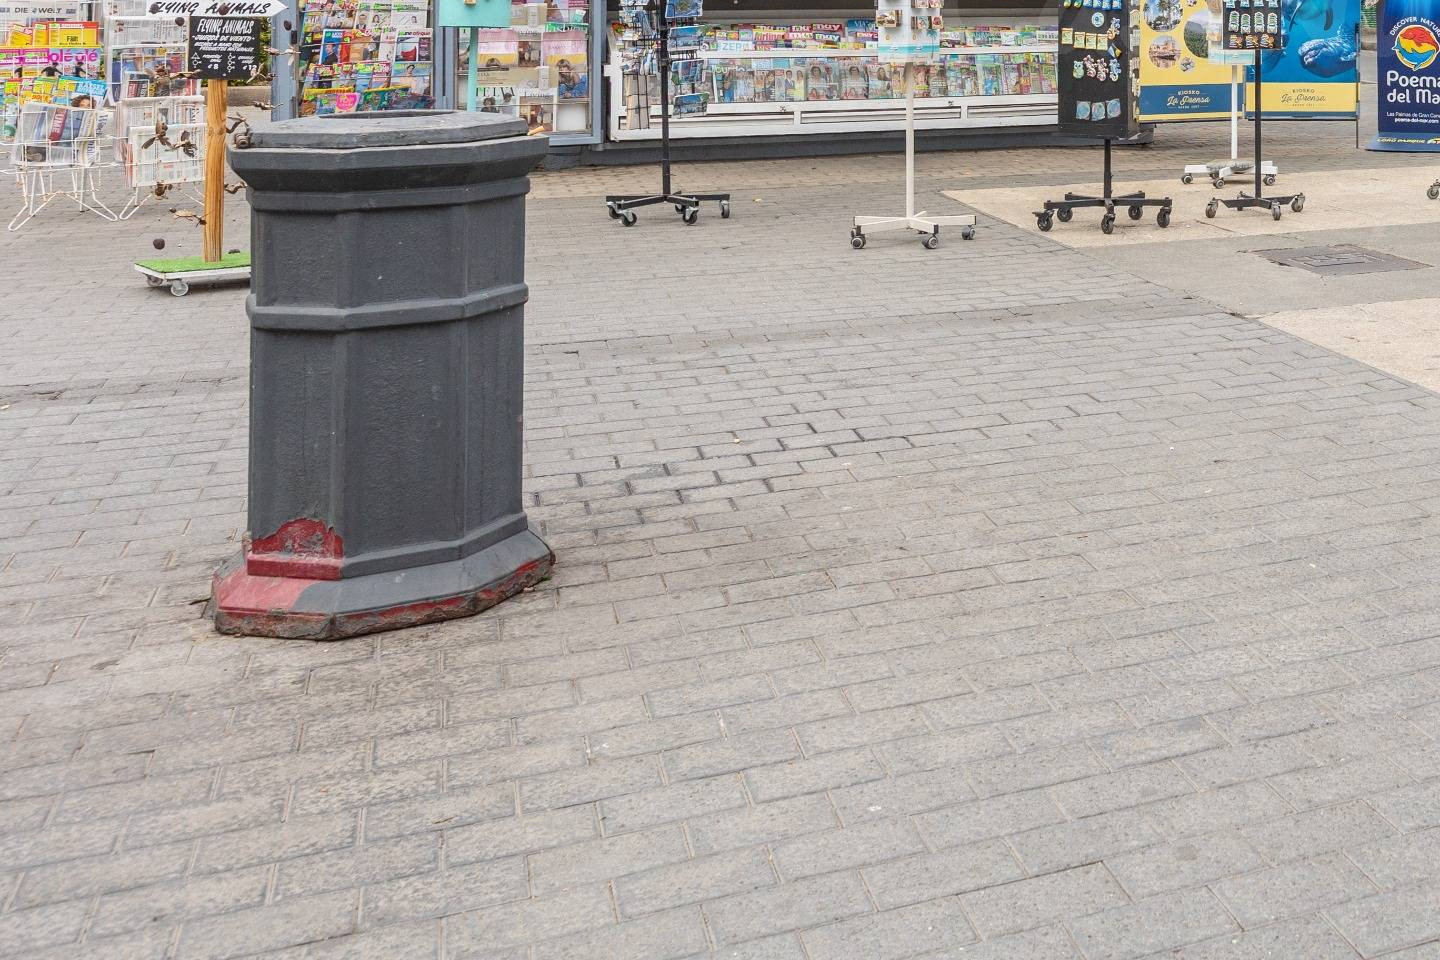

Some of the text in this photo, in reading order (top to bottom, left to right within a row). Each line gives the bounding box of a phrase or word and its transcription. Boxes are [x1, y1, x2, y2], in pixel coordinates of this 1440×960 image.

[222, 19, 255, 34] ANIMALS
[1389, 16, 1418, 36] DISCOVER
[1166, 95, 1211, 106] La Prensa
[1280, 93, 1326, 103] La Prensa
[1386, 88, 1411, 104] del
